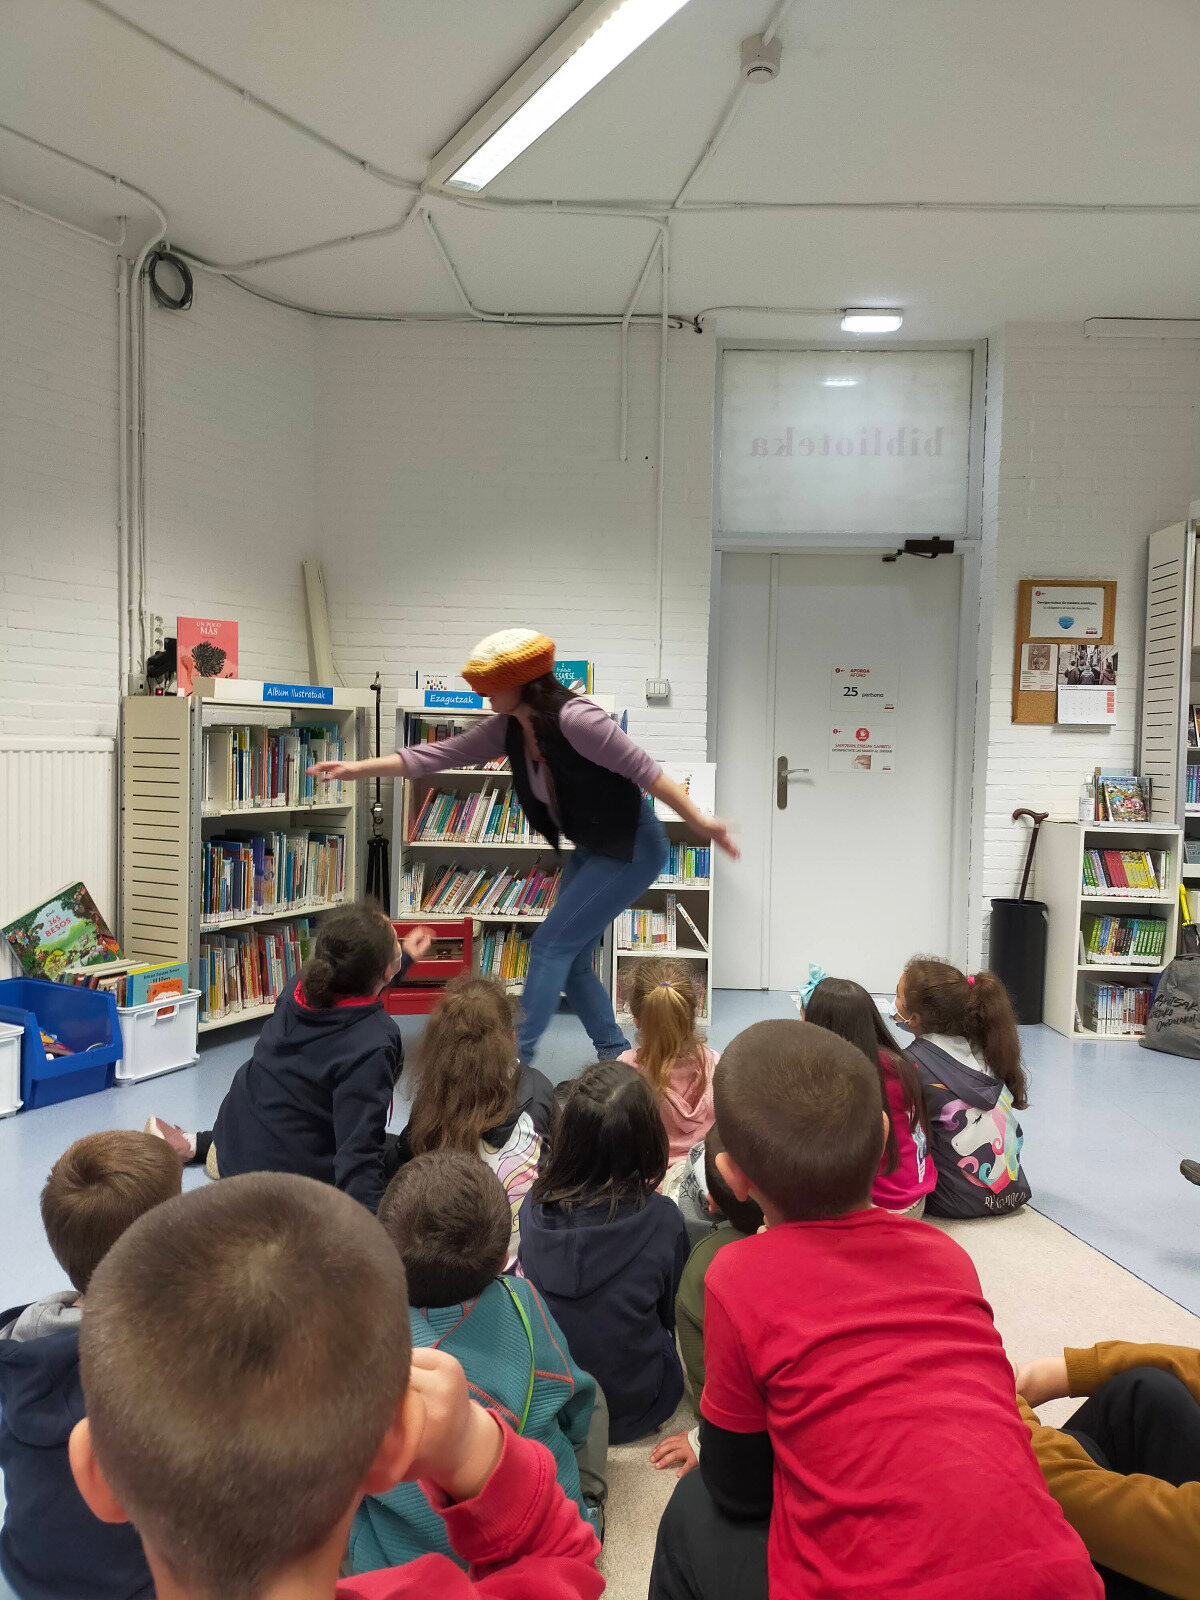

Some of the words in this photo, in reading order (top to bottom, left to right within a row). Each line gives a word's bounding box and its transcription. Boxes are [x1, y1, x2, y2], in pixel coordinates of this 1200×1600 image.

[267, 687, 289, 697] Album
[843, 686, 858, 697] 25
[429, 694, 474, 705] Ezagutzak
[48, 915, 61, 926] 365
[45, 917, 71, 937] BESOS
